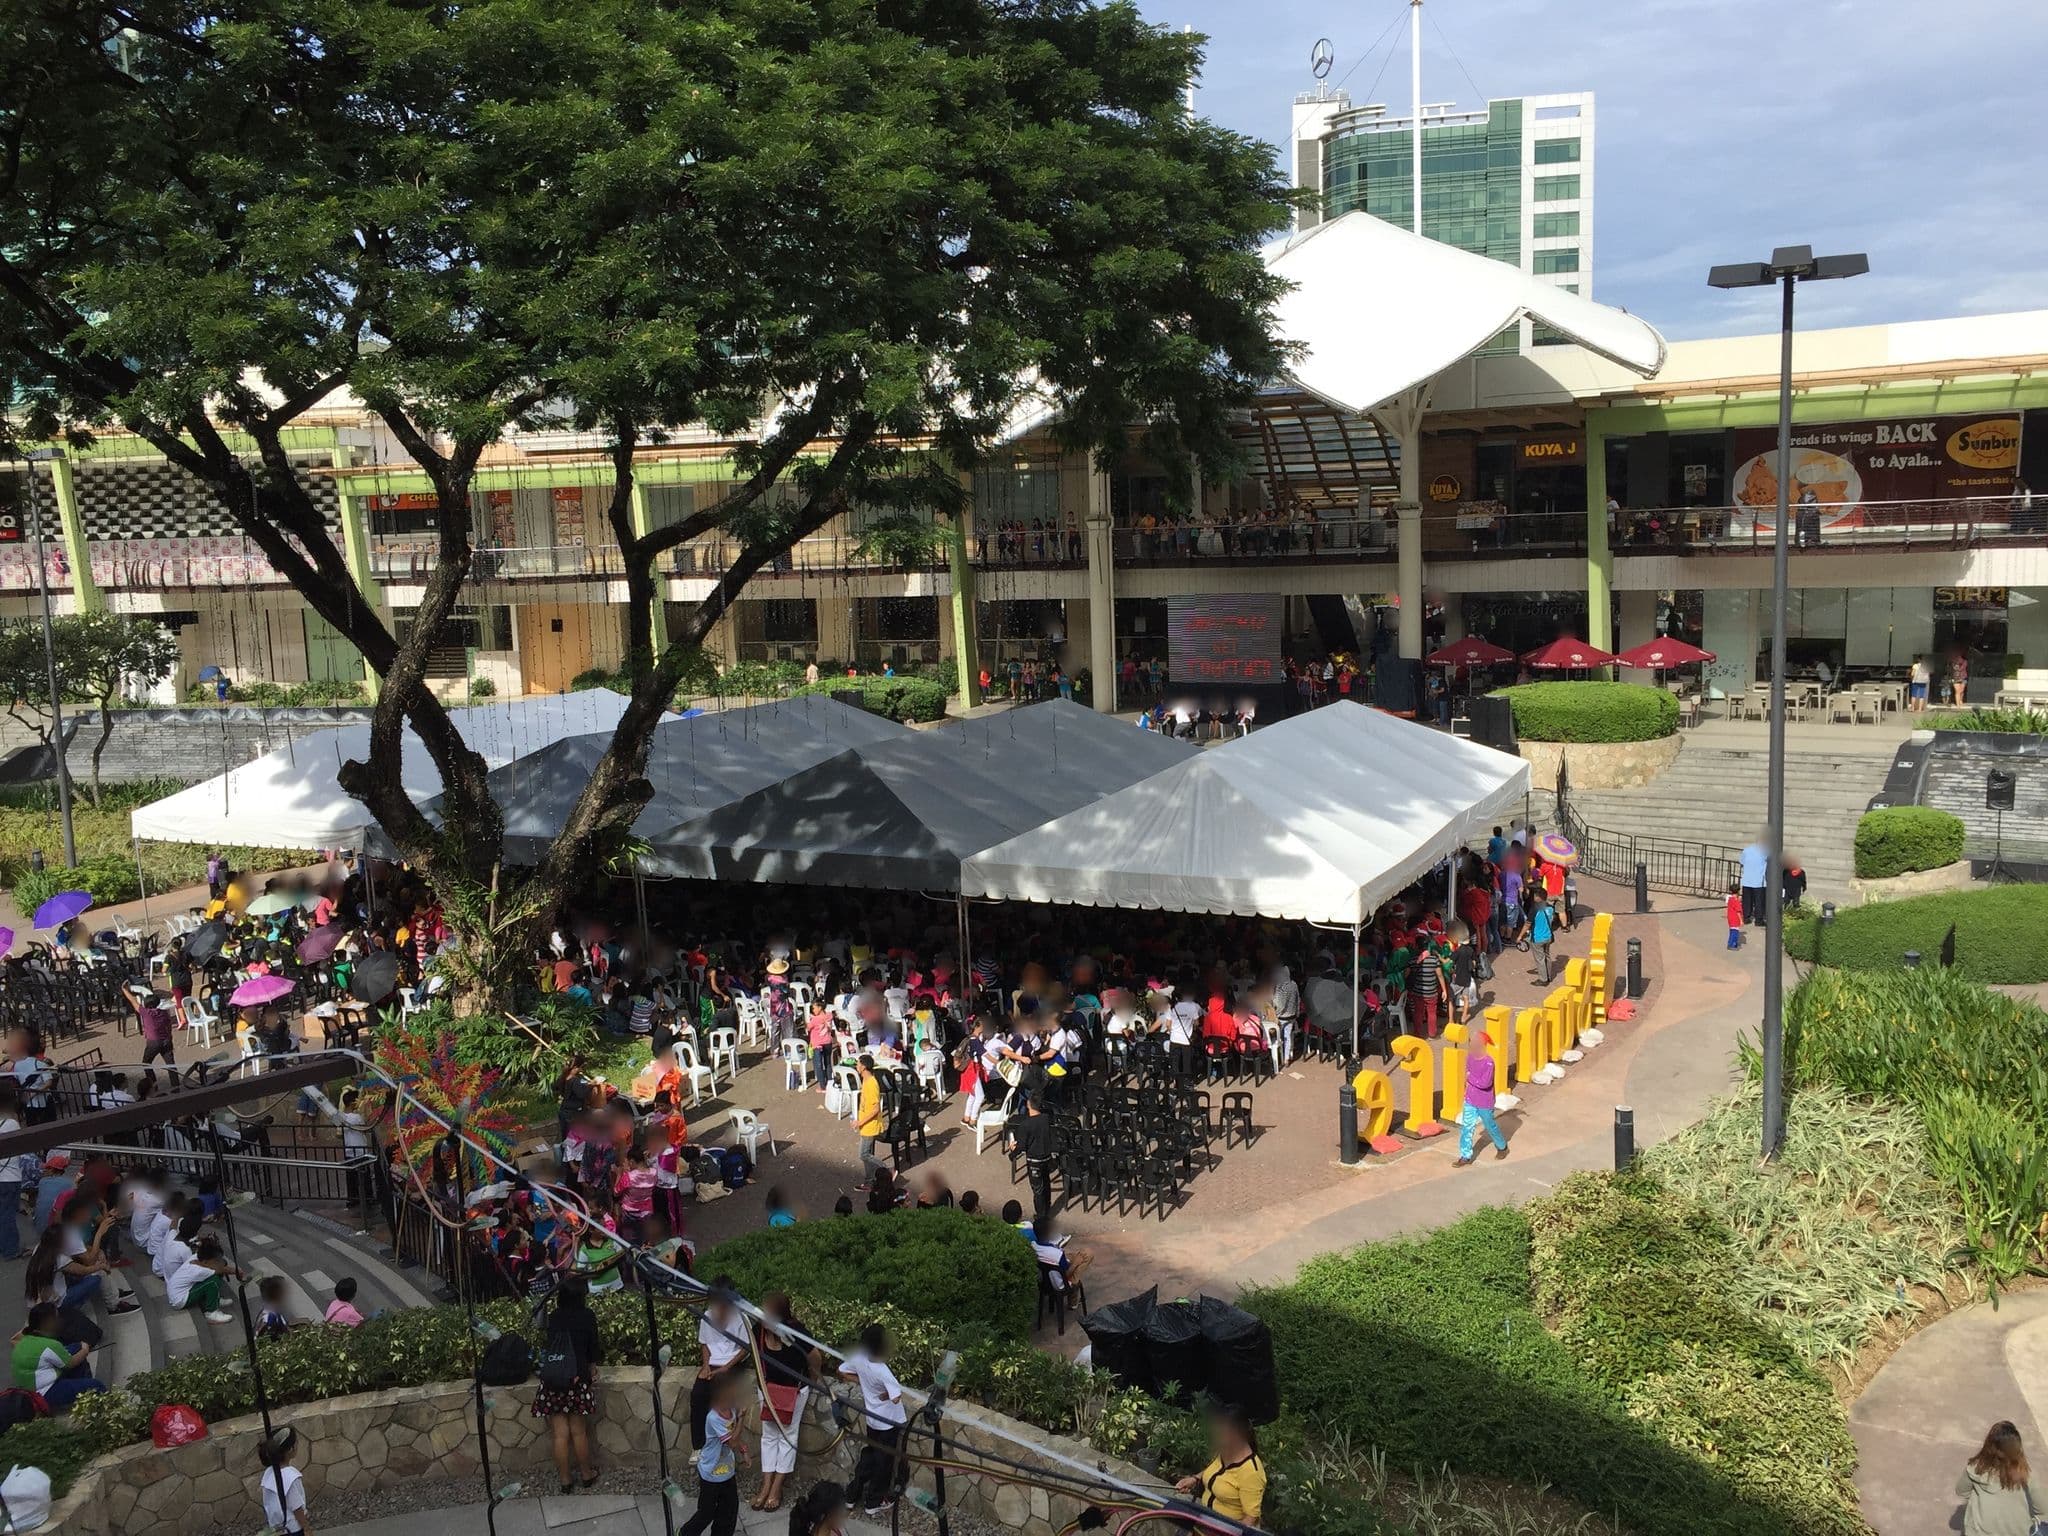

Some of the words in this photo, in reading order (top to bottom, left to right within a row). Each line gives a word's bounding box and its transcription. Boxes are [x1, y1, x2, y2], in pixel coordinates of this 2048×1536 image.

[1778, 433, 1819, 446] reads
[1822, 432, 1837, 444] its
[1839, 431, 1873, 446] wings
[1875, 422, 1938, 445] BACK
[1959, 431, 2018, 451] Sunbur
[1525, 443, 1563, 457] KUYA
[1567, 442, 1576, 454] J
[1869, 456, 1885, 469] to
[1429, 483, 1453, 496] KUYA
[409, 493, 439, 503] CHICK
